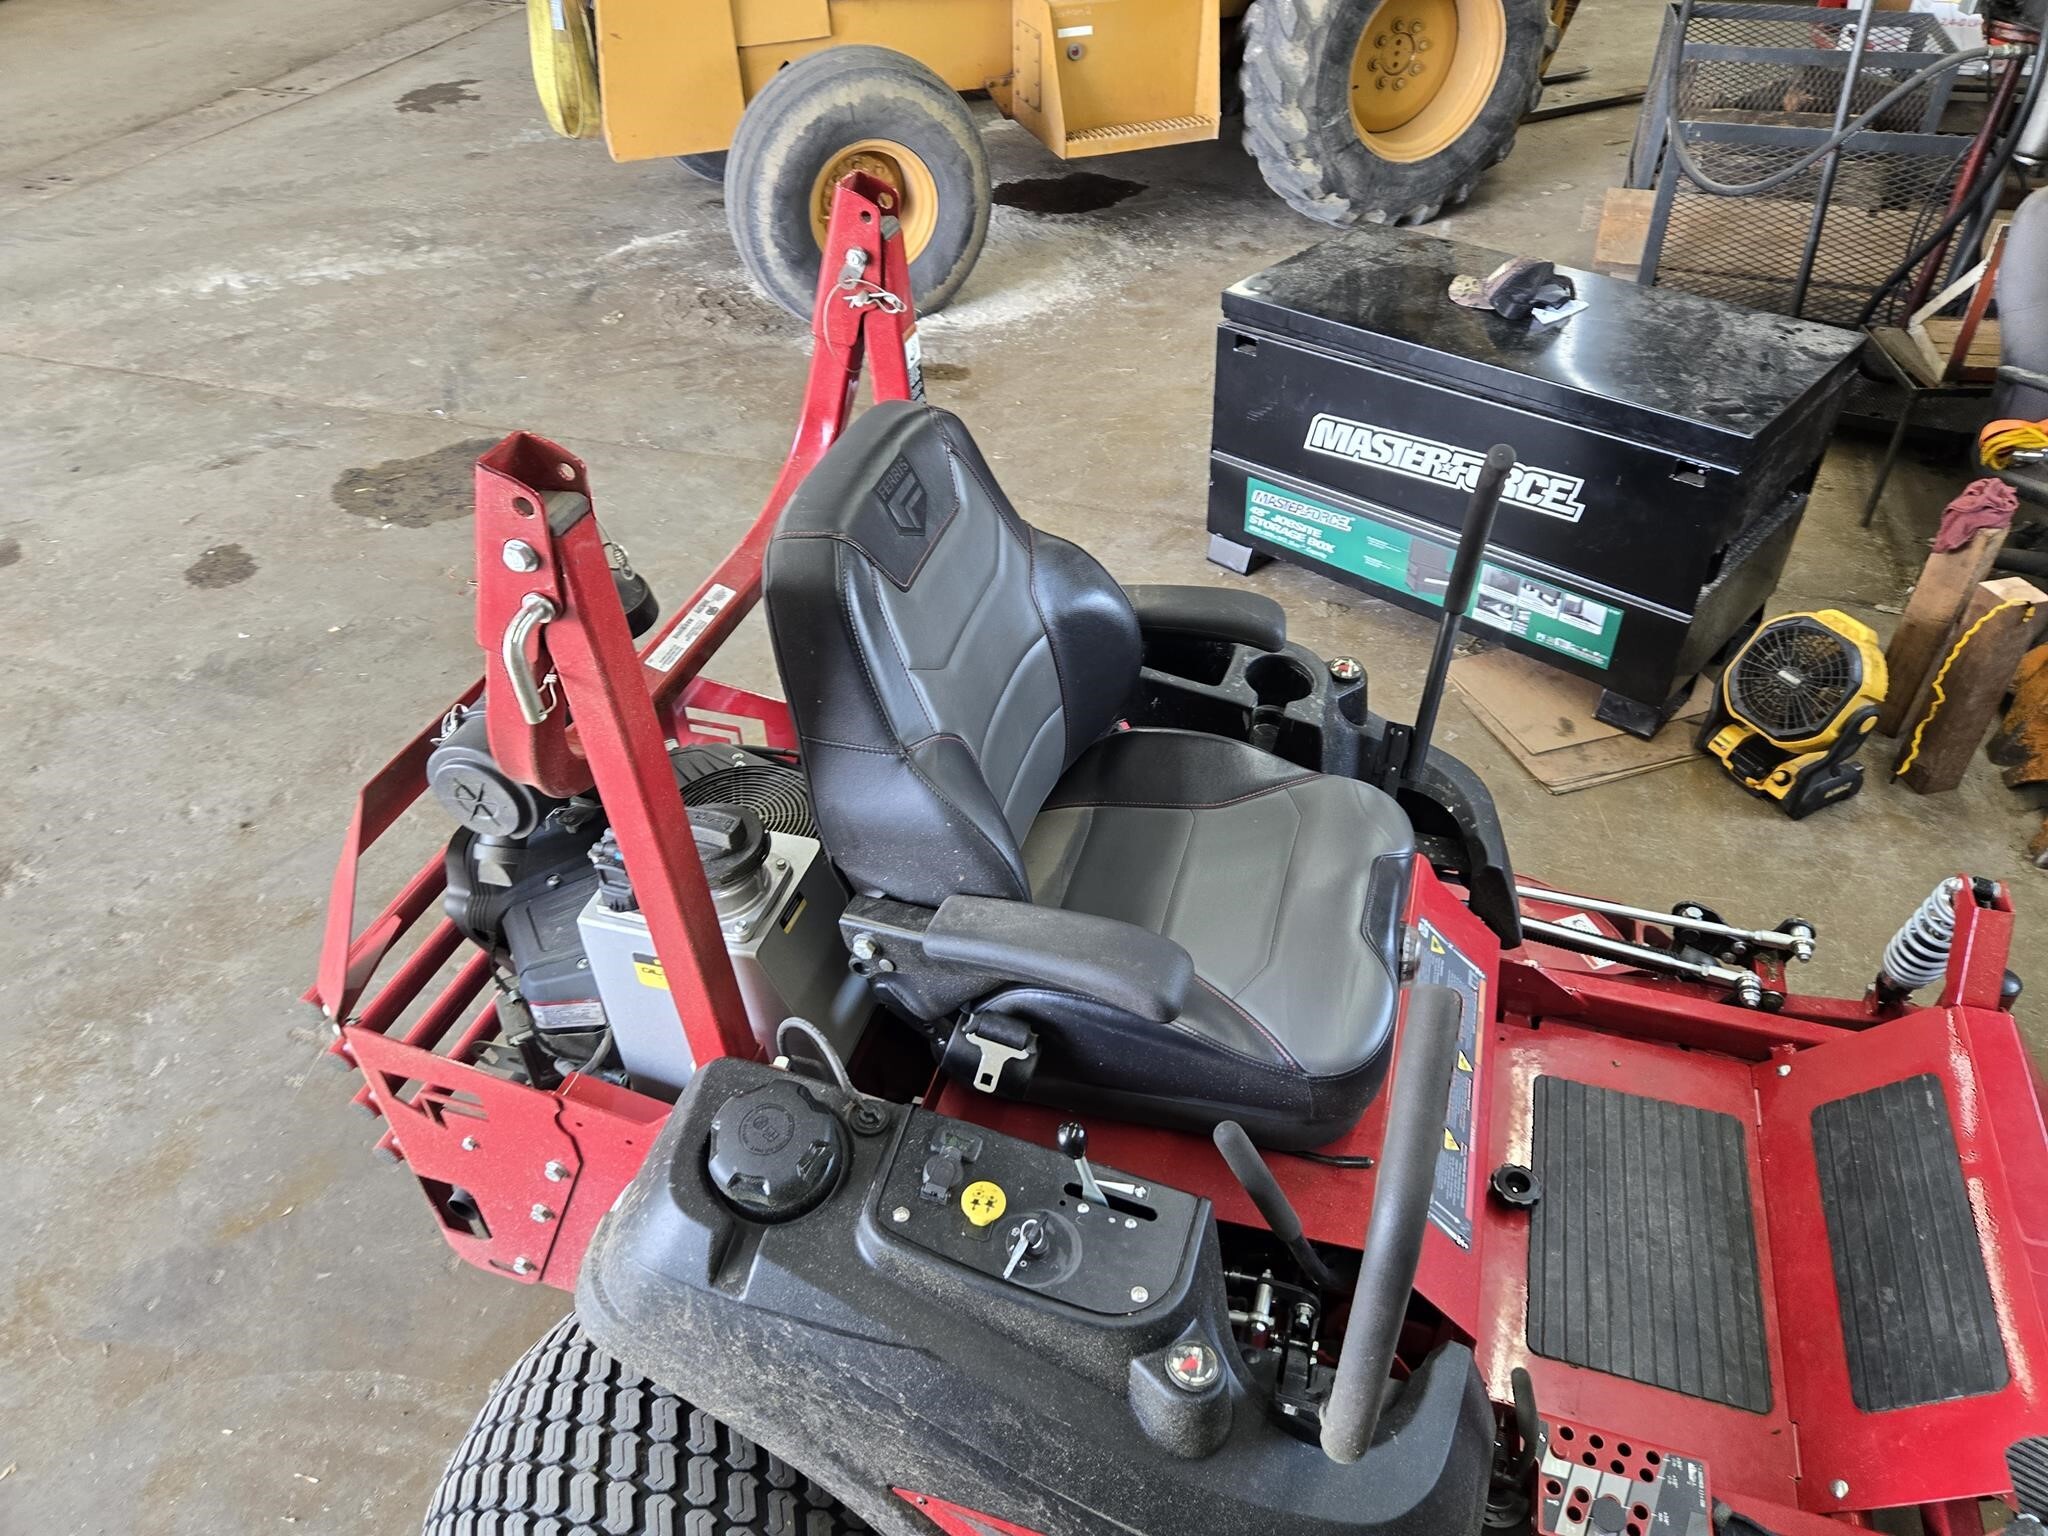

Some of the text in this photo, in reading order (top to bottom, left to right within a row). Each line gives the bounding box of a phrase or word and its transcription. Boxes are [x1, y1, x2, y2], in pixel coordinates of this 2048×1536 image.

[1248, 515, 1308, 543] STORAGE
[1306, 536, 1336, 554] BOX
[1271, 514, 1323, 538] JOBSITE
